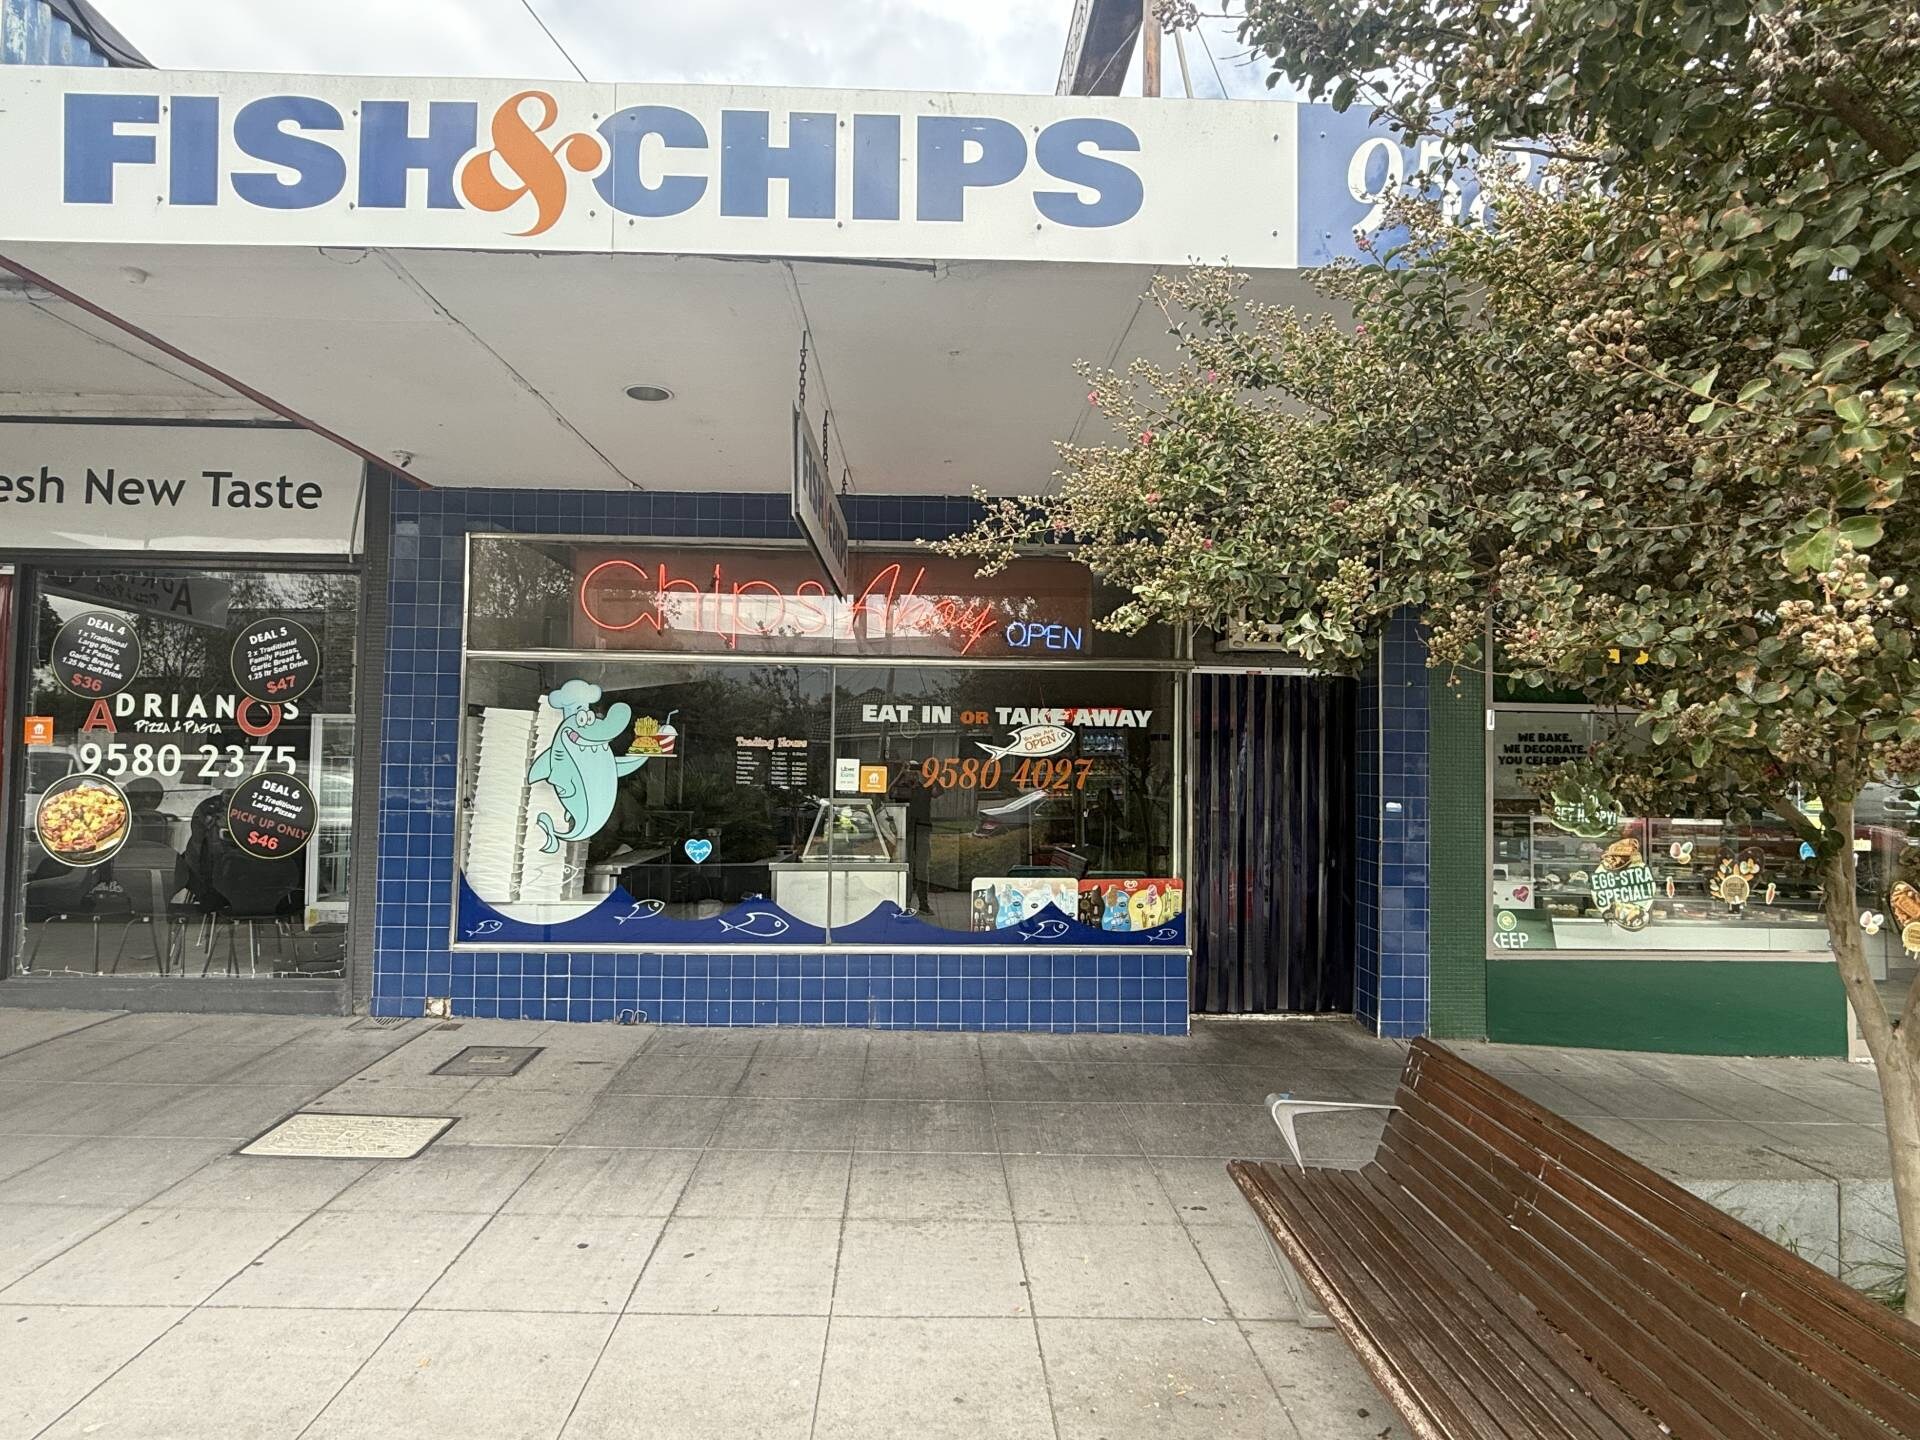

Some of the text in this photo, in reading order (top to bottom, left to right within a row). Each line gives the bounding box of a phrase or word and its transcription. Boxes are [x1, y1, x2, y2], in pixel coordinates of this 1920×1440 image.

[63, 90, 1144, 236] FISH & CHIPS
[85, 468, 186, 506] New
[202, 471, 322, 509] Taste
[581, 560, 826, 649] Chips
[87, 617, 126, 635] DEAL 4
[78, 637, 99, 648] Large
[90, 632, 128, 648] Traditional
[249, 627, 288, 644] DEAL 5
[1006, 621, 1082, 650] OPEN
[259, 638, 297, 654] Traditional
[69, 650, 91, 662] Garlic
[91, 657, 114, 669] Bread
[249, 654, 273, 665] Family
[250, 662, 272, 672] Garlic
[273, 655, 295, 666] Bread
[87, 664, 103, 673] Soft
[103, 669, 123, 679] Drink
[248, 672, 263, 680] 1.25
[273, 665, 288, 674] Soft
[289, 659, 309, 669] Drink
[71, 673, 103, 692] $36
[266, 675, 296, 694] $47
[863, 705, 1152, 728] EAT IN OR TAKE AWAY
[172, 721, 181, 732] &
[1025, 733, 1056, 751] OPEN
[1518, 733, 1572, 742] WE BAKE.
[1504, 745, 1587, 754] WE DECORATE.
[80, 743, 296, 777] 9580 2375
[1498, 756, 1522, 765] YOU
[922, 757, 1093, 790] 9580 4027
[262, 780, 300, 799] DEAL 6
[252, 801, 272, 811] Large
[265, 796, 303, 812] Traditional
[230, 809, 308, 839] PICK UP ONLY
[248, 831, 278, 849] $46
[1591, 867, 1653, 889] EGG-STRA
